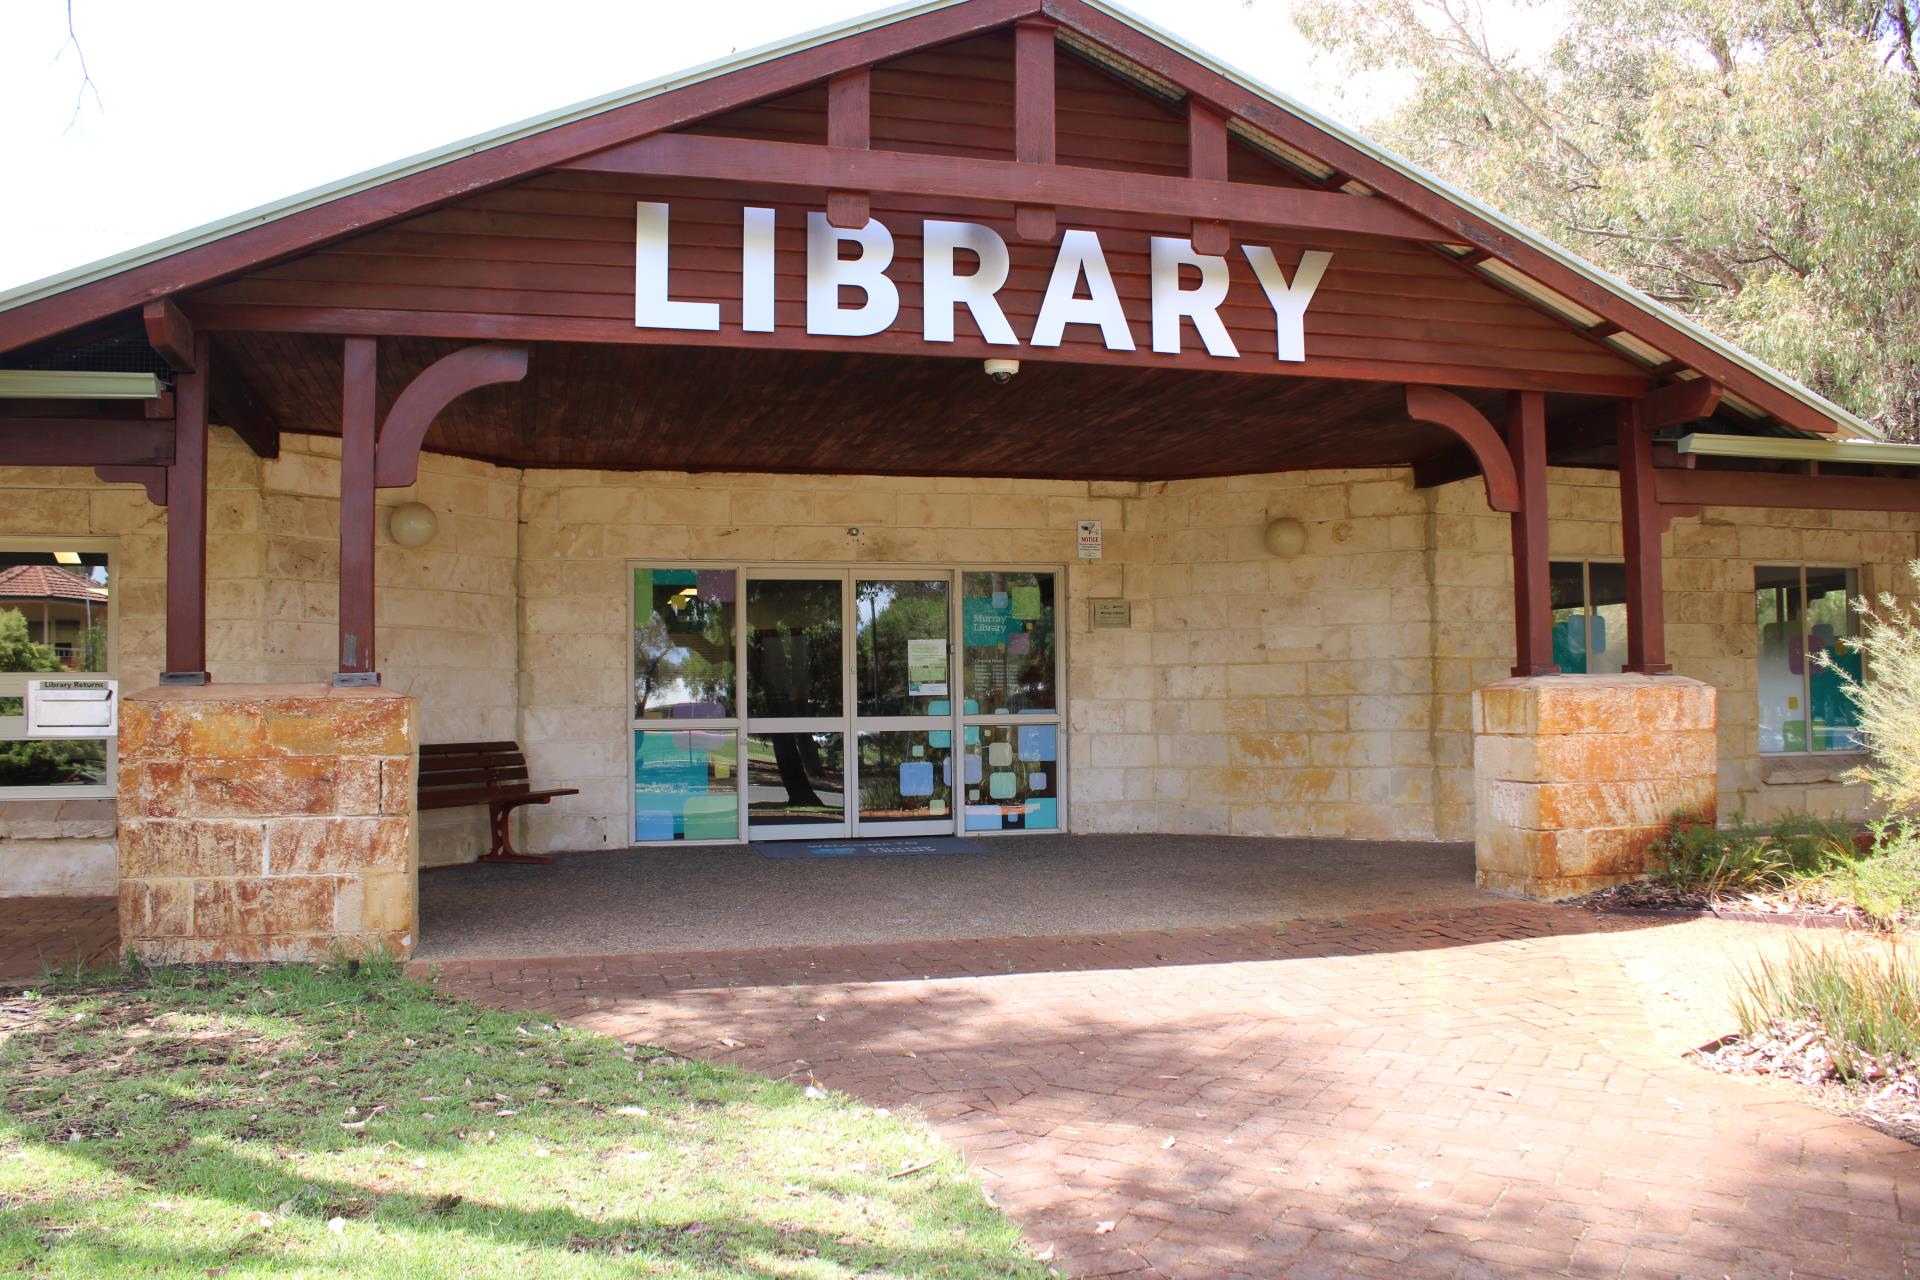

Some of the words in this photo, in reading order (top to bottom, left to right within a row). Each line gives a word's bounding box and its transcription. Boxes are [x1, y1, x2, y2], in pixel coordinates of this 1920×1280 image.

[635, 201, 1334, 363] LIBRARY
[973, 614, 1007, 624] Murray
[973, 623, 1007, 632] Library
[44, 681, 71, 689] Library
